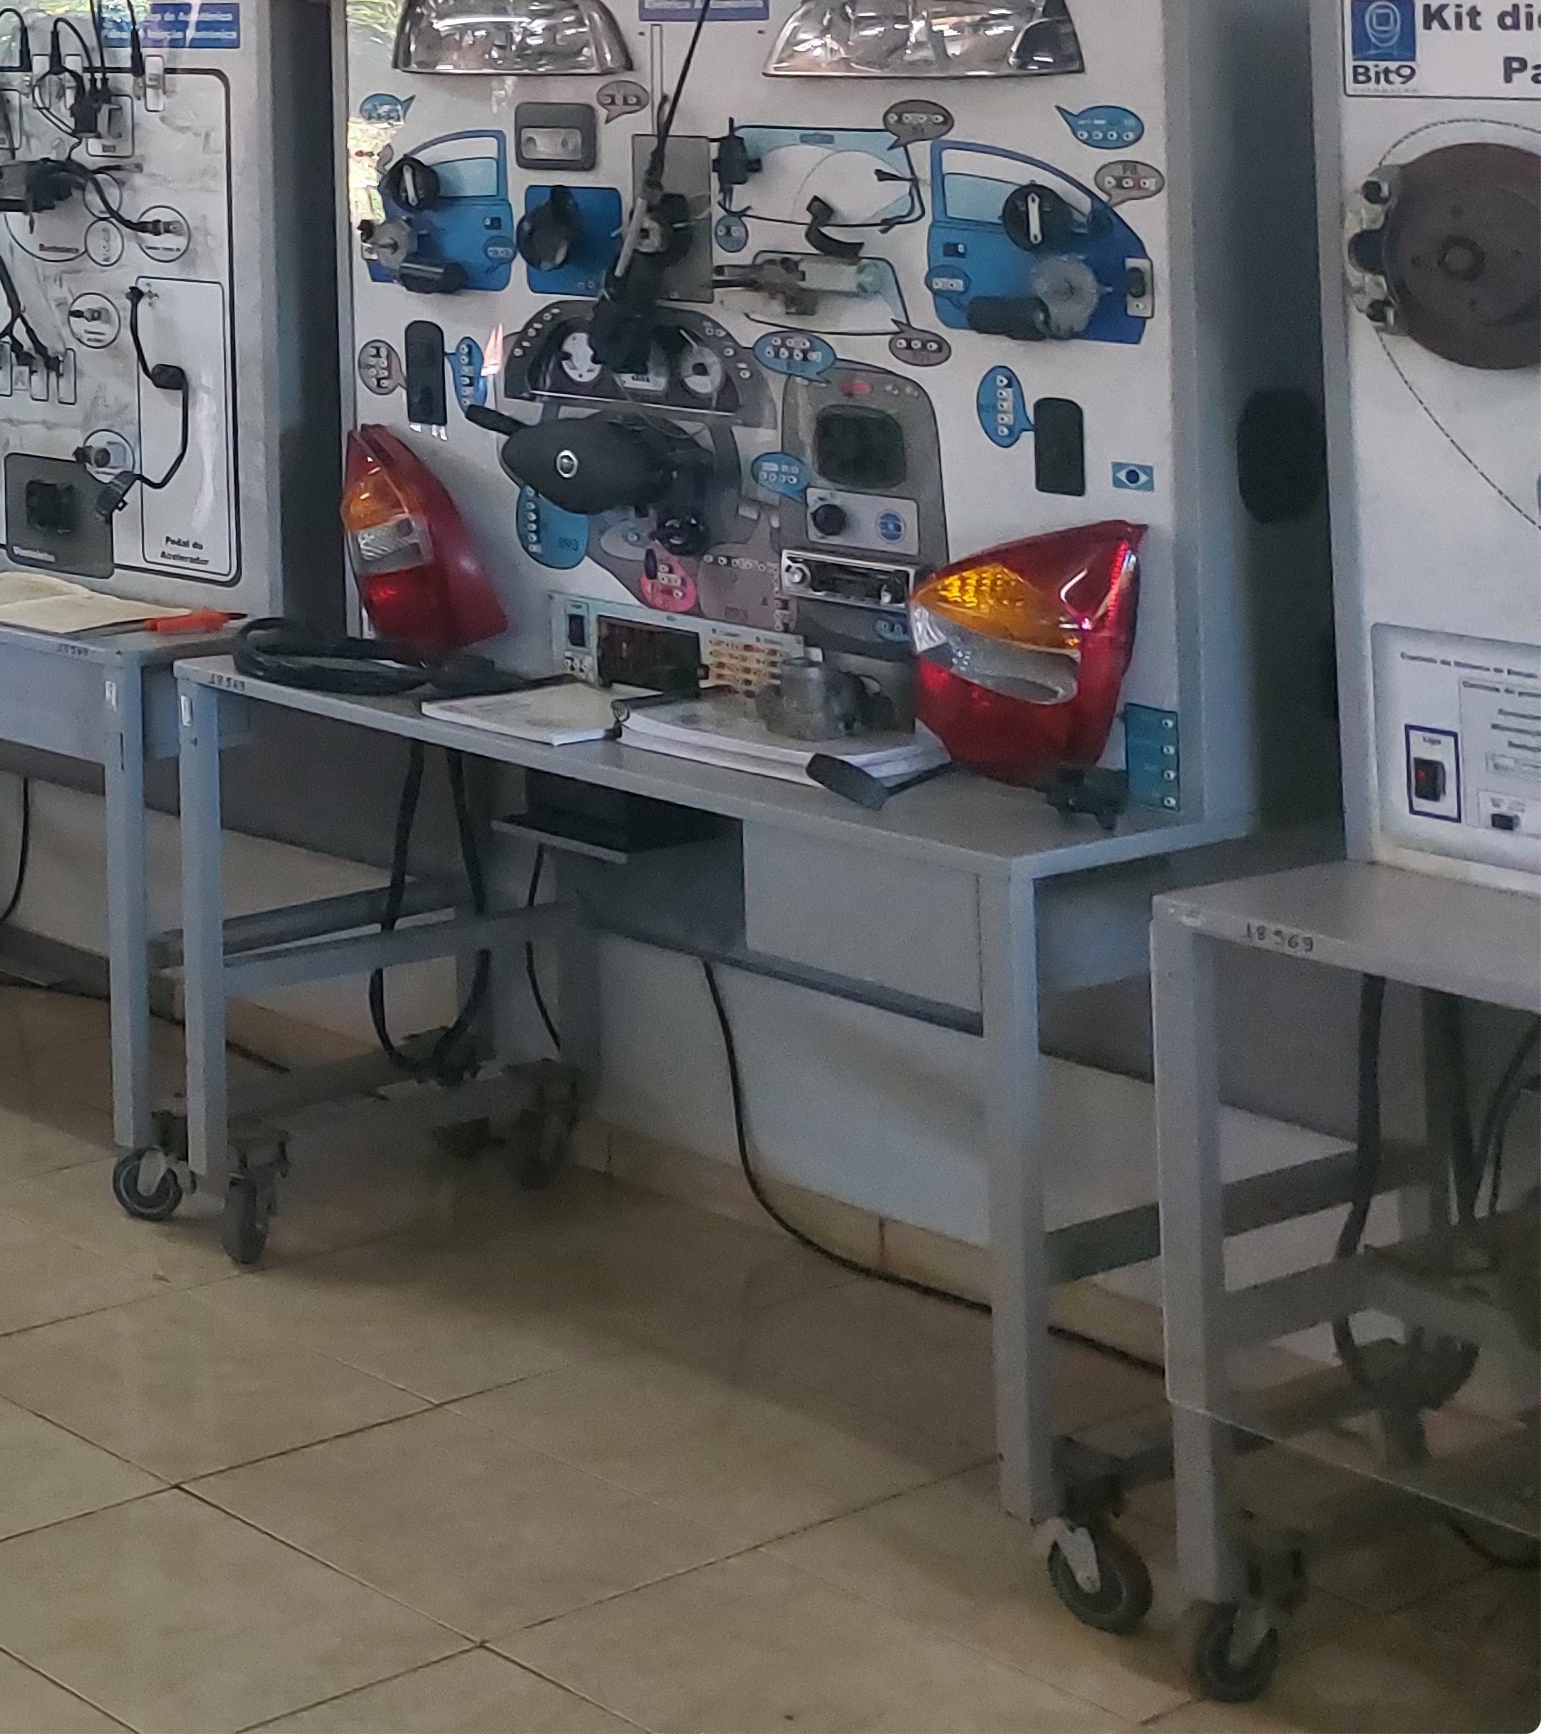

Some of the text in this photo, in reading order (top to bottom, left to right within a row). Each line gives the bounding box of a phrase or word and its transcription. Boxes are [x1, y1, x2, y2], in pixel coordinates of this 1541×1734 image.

[1422, 3, 1541, 31] Kit di
[1352, 64, 1416, 85] Bit9
[165, 535, 190, 548] Pedal
[1242, 922, 1314, 952] 18569
